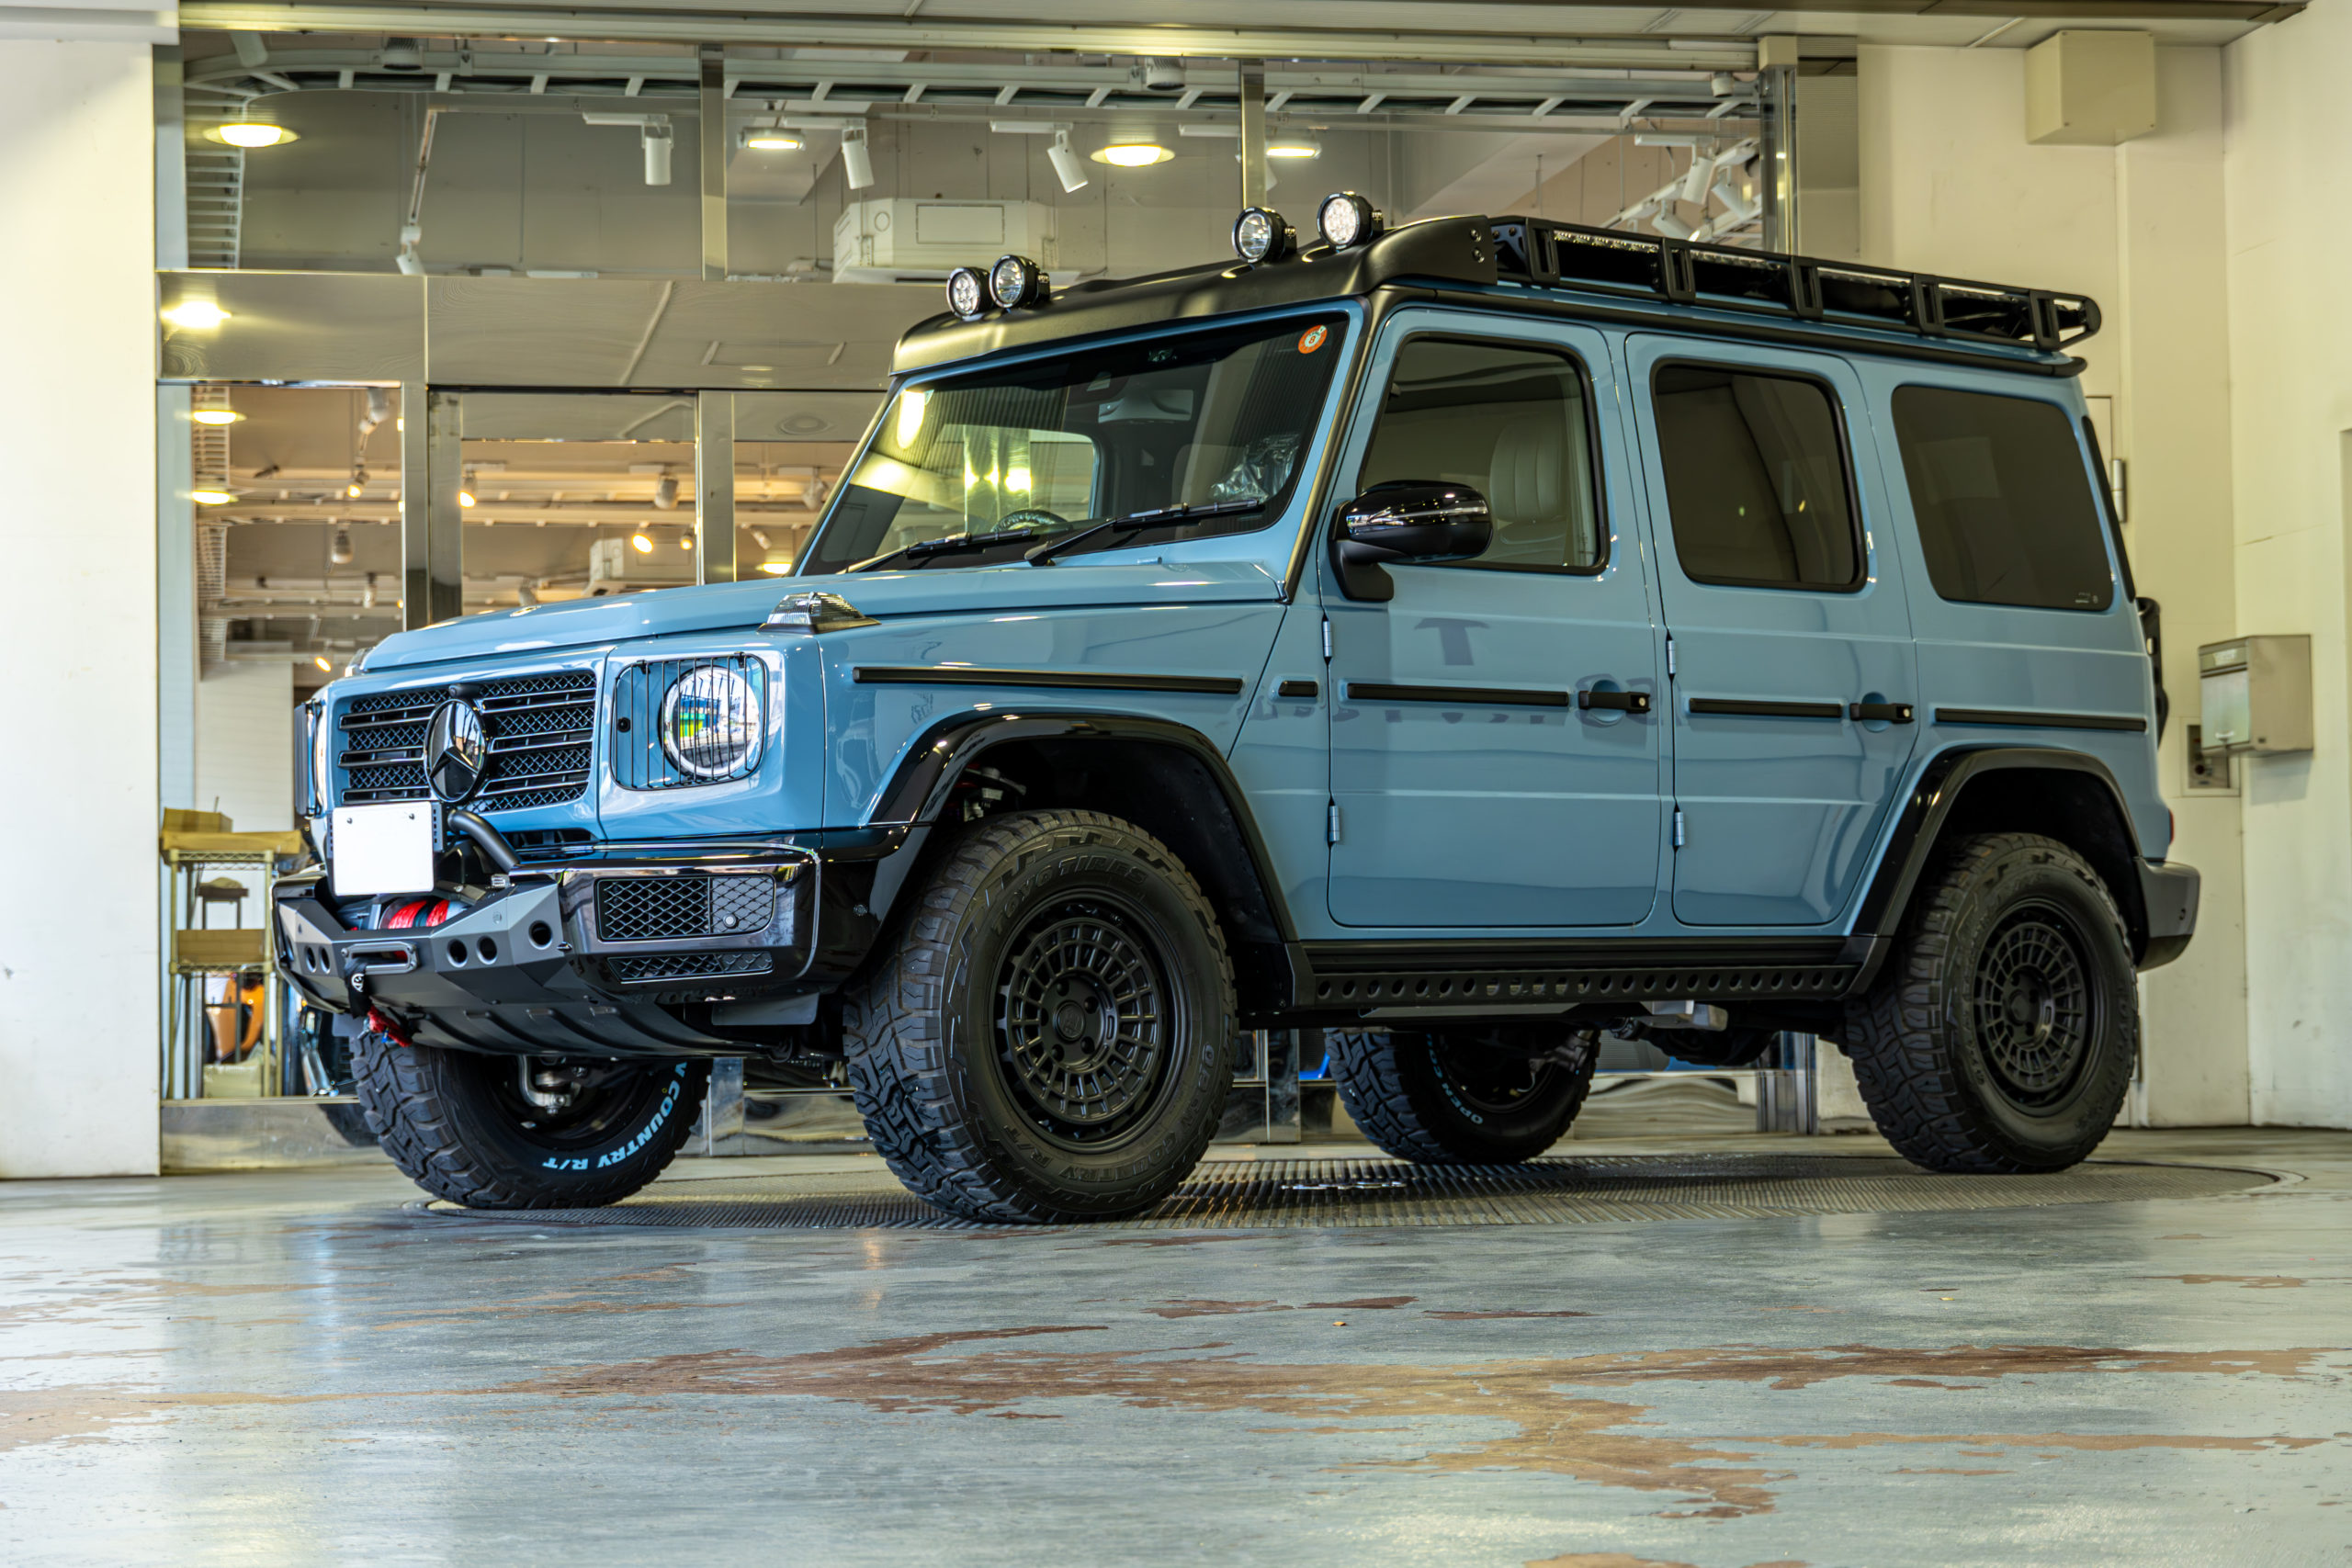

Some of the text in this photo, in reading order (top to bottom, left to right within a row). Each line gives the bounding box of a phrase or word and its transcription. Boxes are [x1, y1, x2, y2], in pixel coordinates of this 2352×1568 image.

[991, 855, 1148, 937] TOYO TIRES
[542, 1080, 681, 1170] COUNTRY R/T
[1442, 1083, 1483, 1124] OPEN
[1058, 1132, 1177, 1182] COUNTRY
